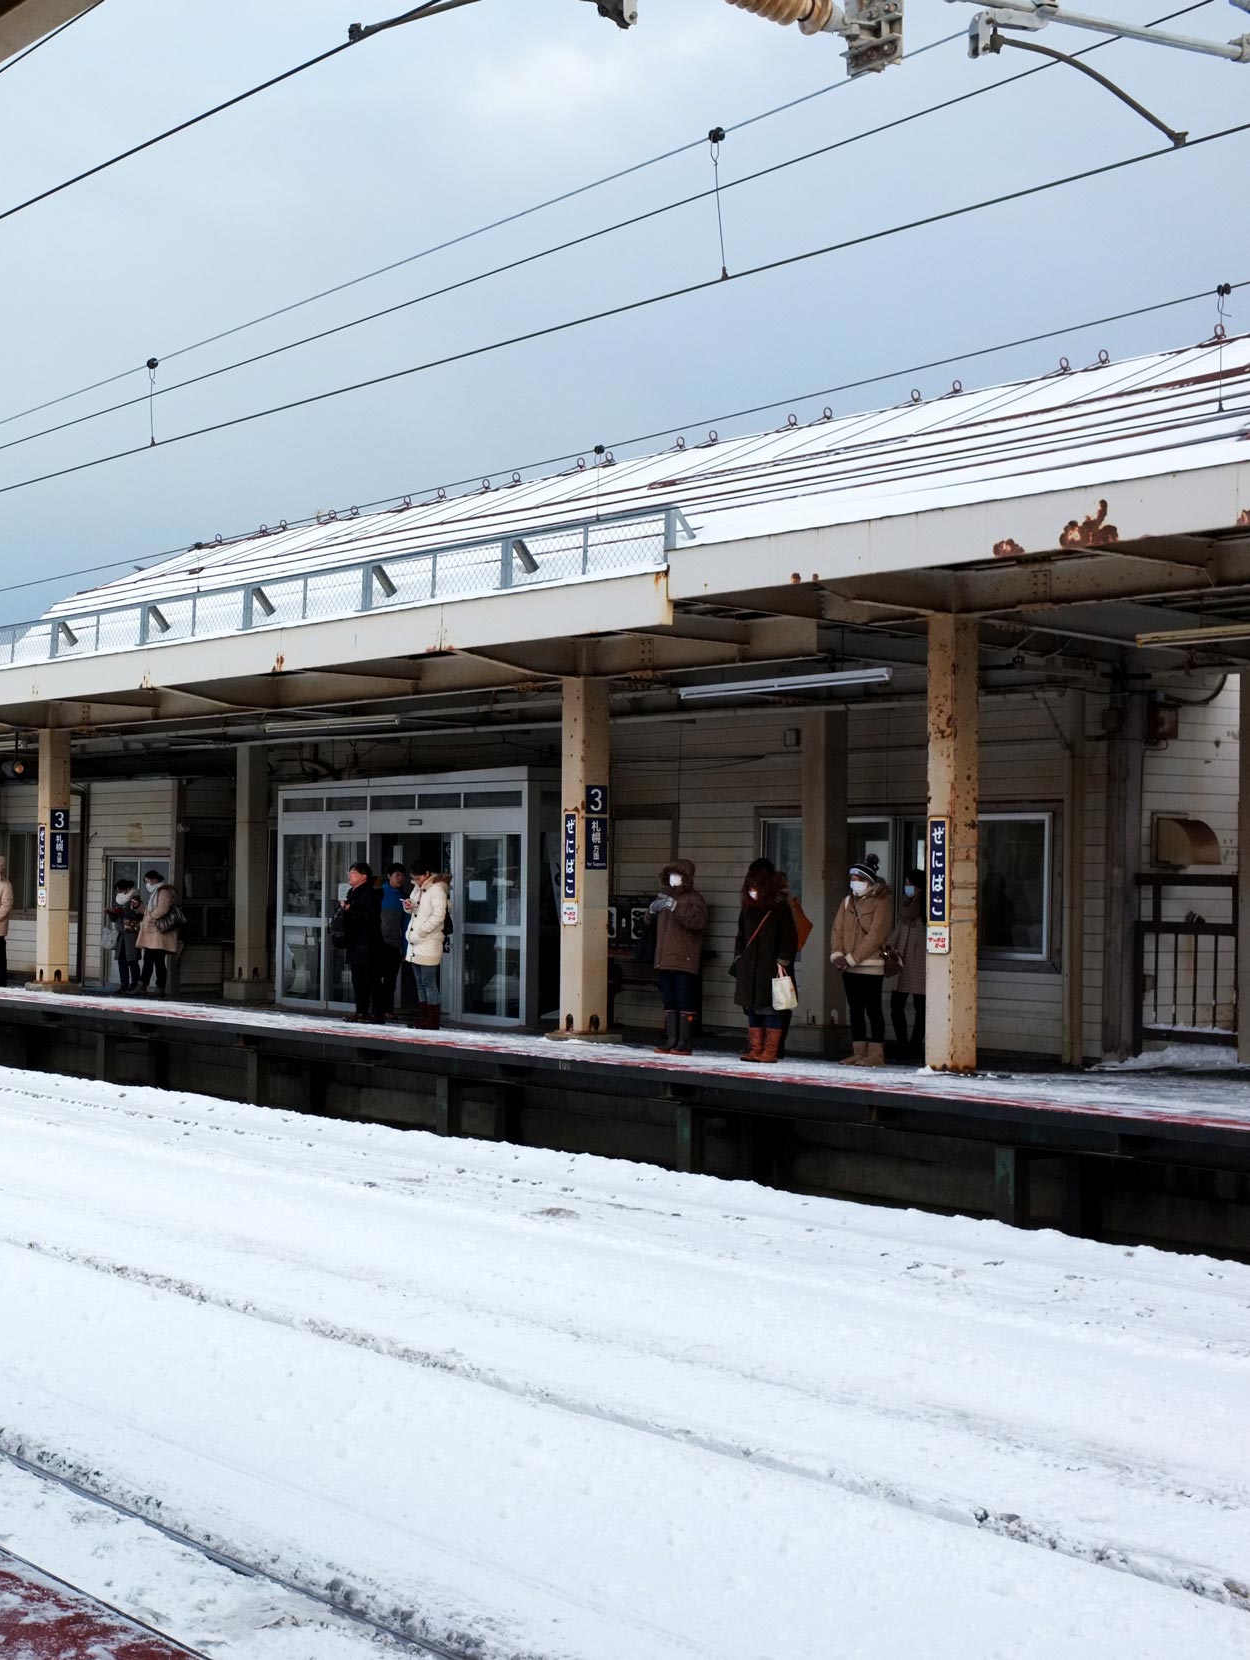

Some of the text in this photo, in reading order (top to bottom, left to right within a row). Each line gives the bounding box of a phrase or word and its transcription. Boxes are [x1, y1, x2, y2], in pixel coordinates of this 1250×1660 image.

[54, 811, 64, 828] 3
[590, 788, 602, 811] 3
[566, 819, 575, 893] ぜにばこ
[932, 826, 945, 916] ぜにばこ
